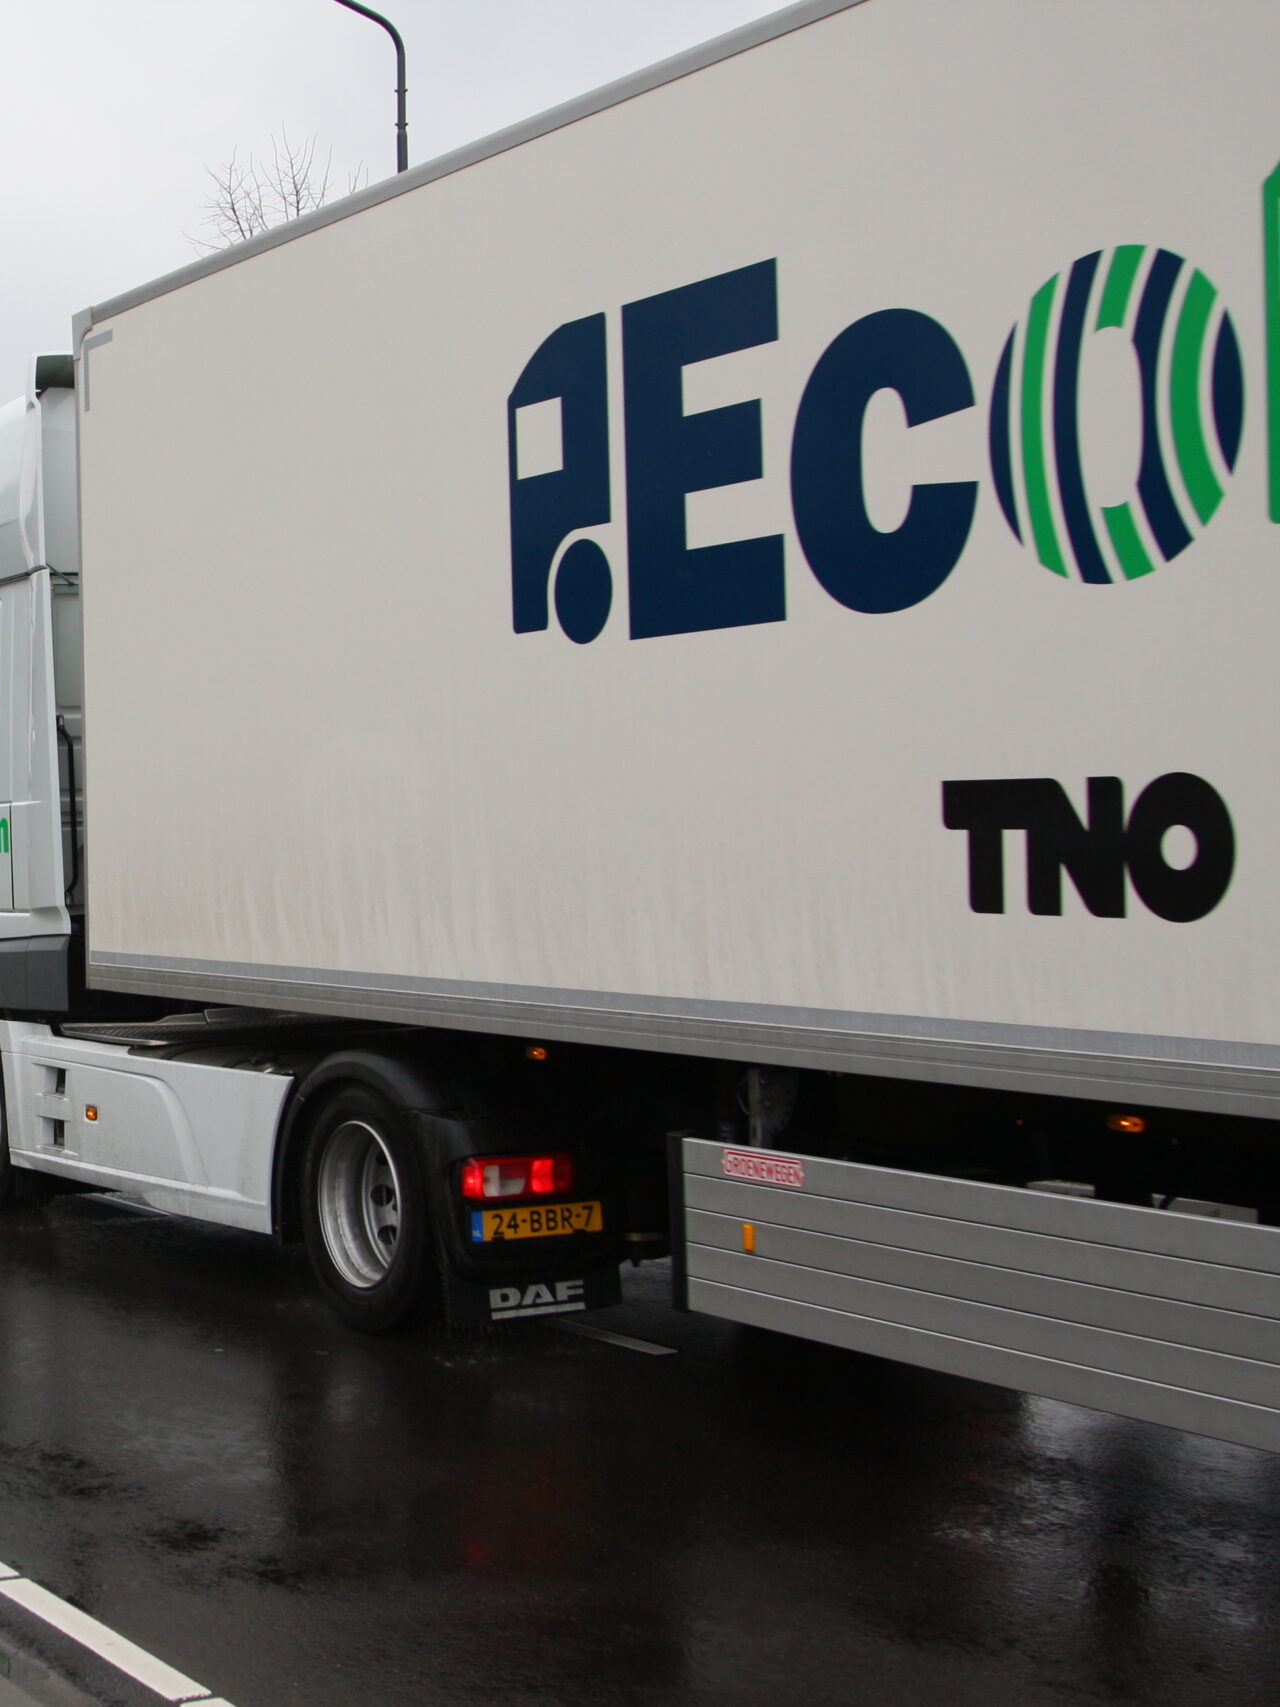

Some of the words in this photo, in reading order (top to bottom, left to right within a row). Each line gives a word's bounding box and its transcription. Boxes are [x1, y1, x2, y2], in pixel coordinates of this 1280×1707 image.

[942, 772, 1236, 923] TNO
[725, 1151, 803, 1185] GROENEWEGEN
[492, 1205, 594, 1237] 24-BBR-7
[489, 1280, 584, 1309] DAF
